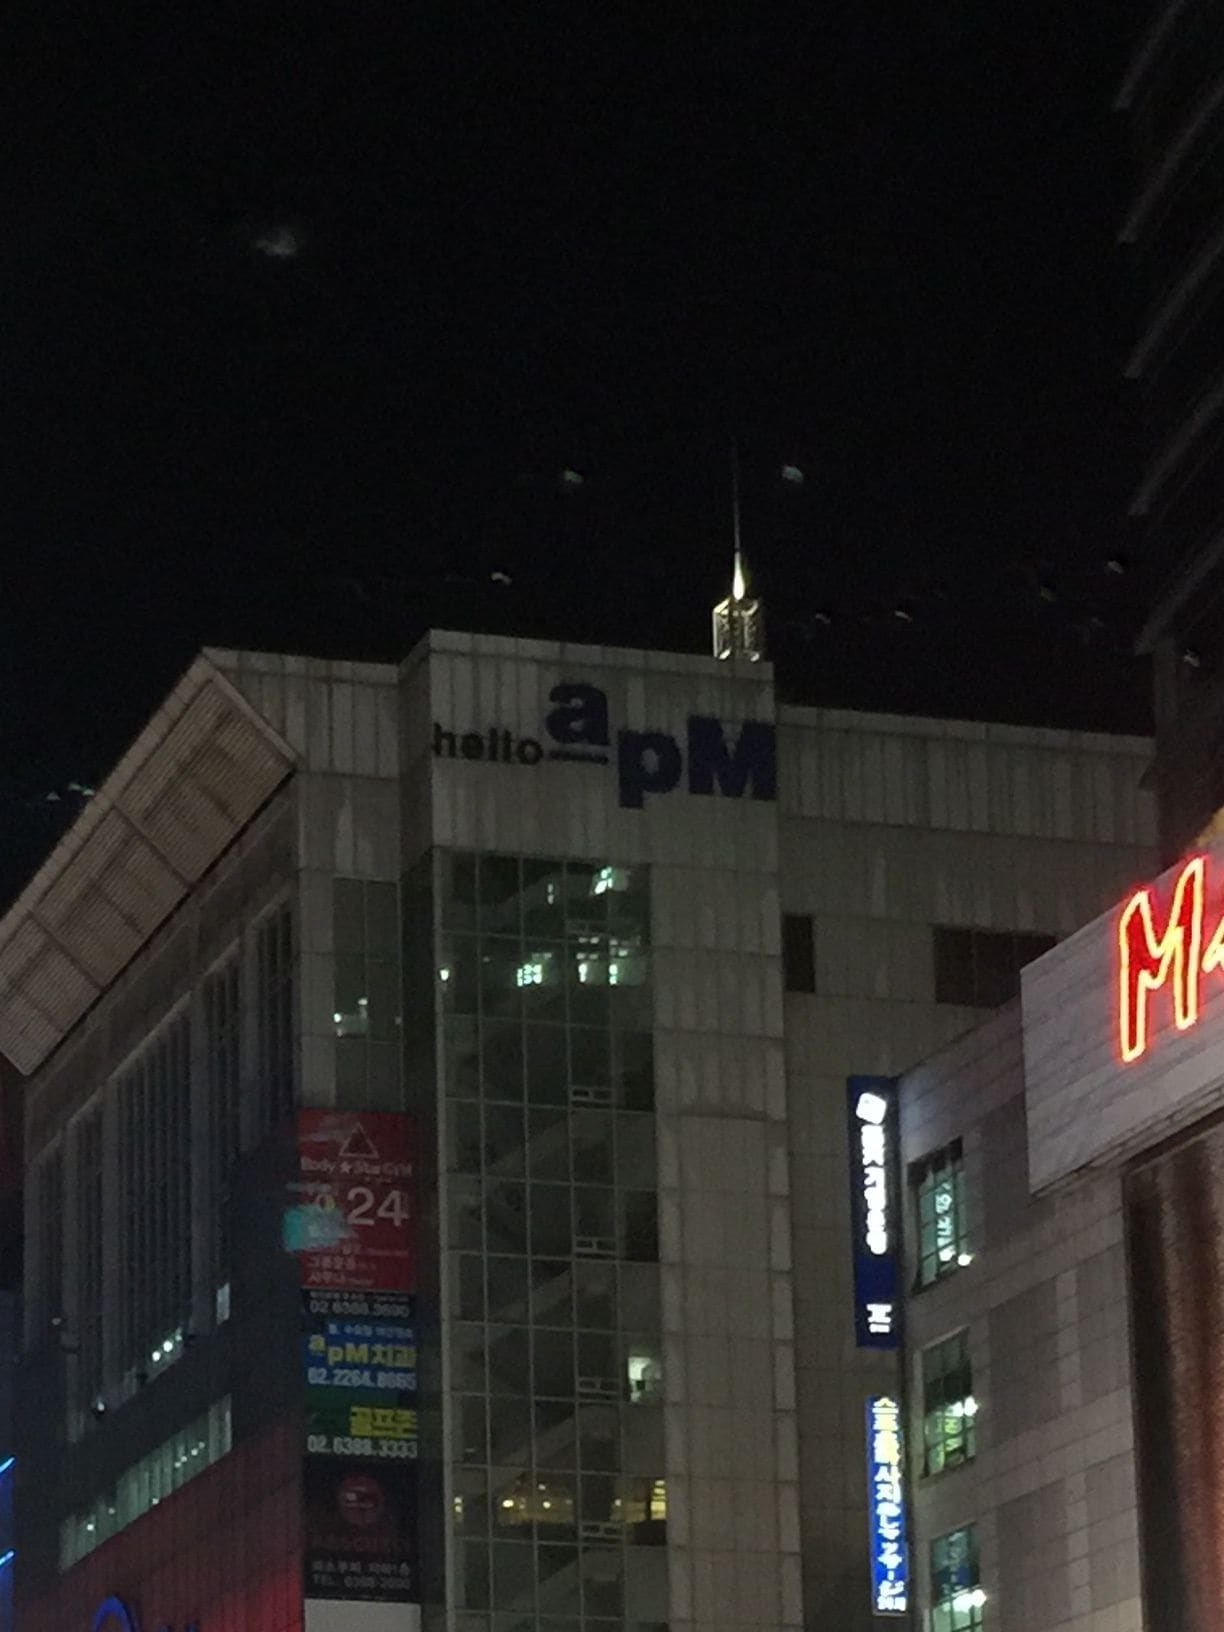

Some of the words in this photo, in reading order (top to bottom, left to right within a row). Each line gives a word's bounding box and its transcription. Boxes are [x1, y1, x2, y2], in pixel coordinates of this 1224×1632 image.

[432, 721, 544, 766] hello
[545, 682, 776, 809] apM
[346, 1185, 410, 1228] 24
